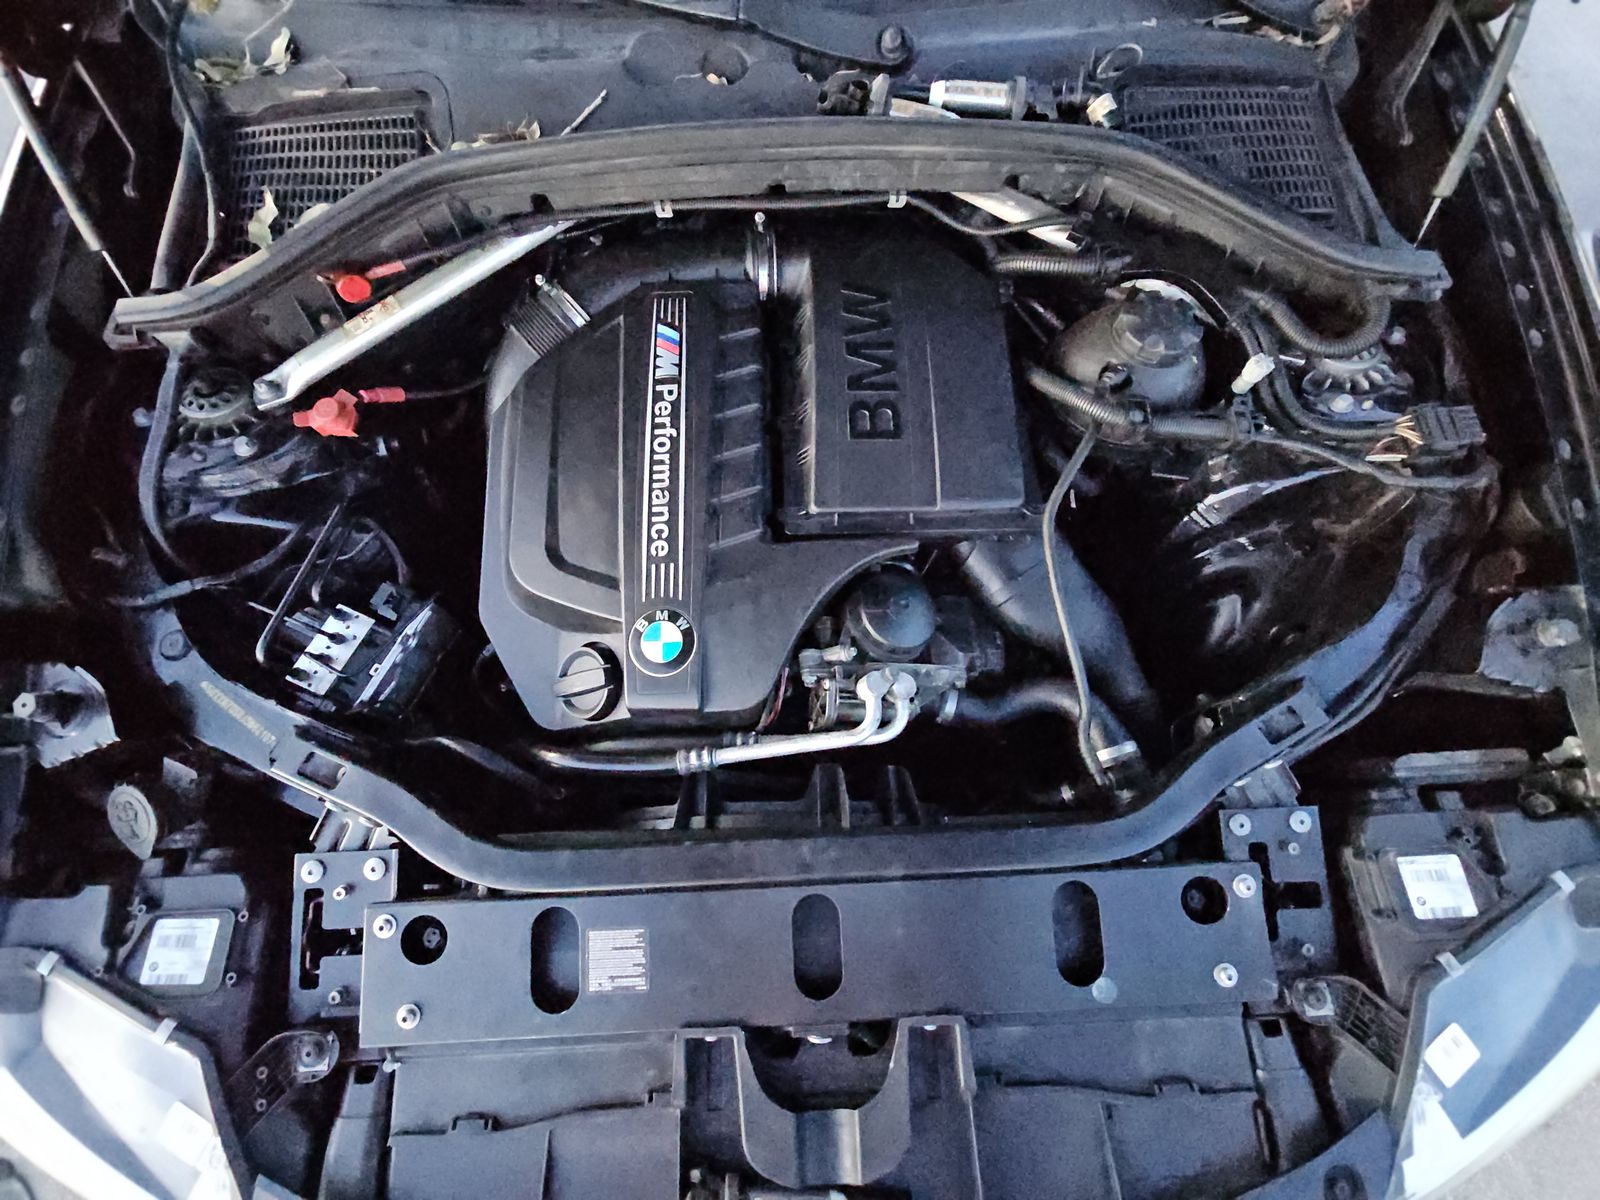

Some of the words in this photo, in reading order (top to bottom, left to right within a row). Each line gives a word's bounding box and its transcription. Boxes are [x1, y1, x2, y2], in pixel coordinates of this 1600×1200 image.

[841, 282, 902, 440] BMW
[650, 383, 679, 558] Performance
[635, 609, 690, 633] BMW
